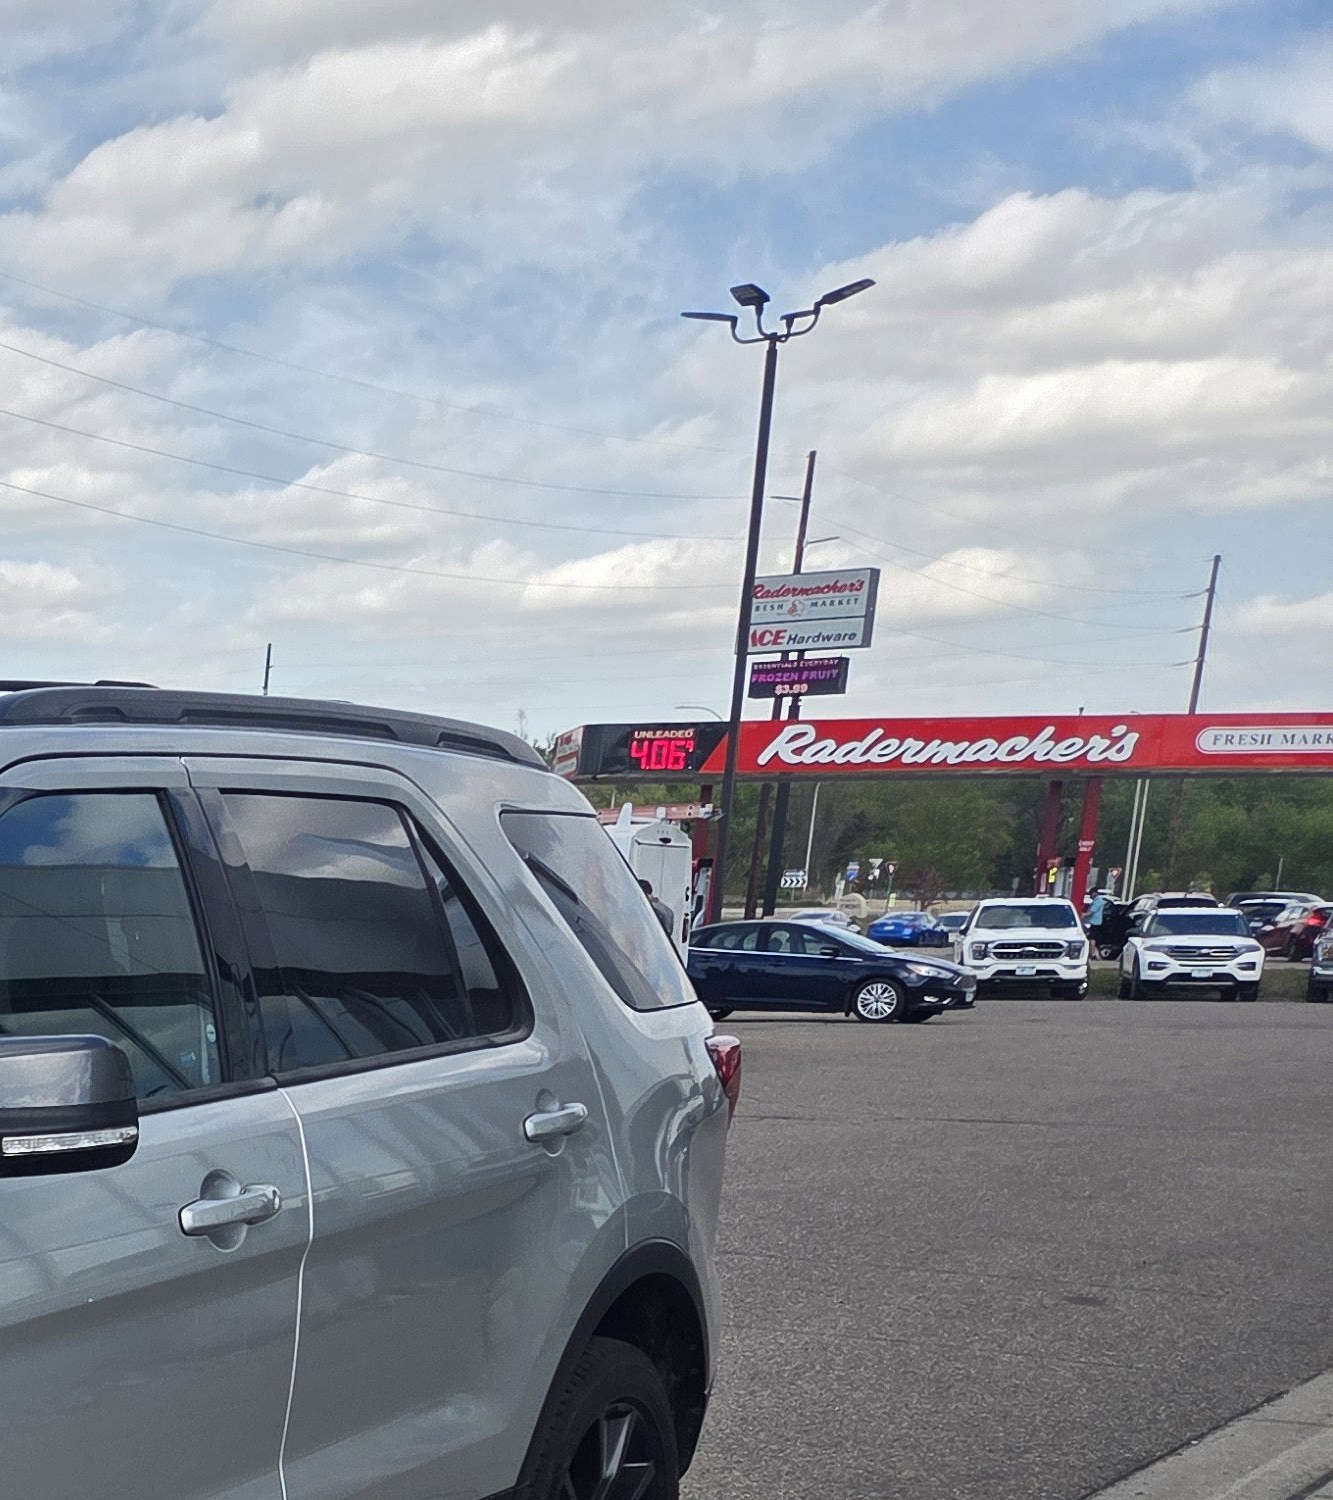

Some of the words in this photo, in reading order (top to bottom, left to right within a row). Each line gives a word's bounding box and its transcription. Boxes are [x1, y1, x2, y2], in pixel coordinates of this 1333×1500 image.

[754, 603, 784, 612] RESH
[809, 598, 859, 608] MARKET
[786, 632, 857, 645] Hardware
[752, 671, 799, 683] FROZEN
[802, 669, 839, 680] FRUIT
[634, 728, 696, 739] UNLEADED
[1212, 733, 1272, 746] FRESH
[758, 724, 1140, 766] Radermacher's
